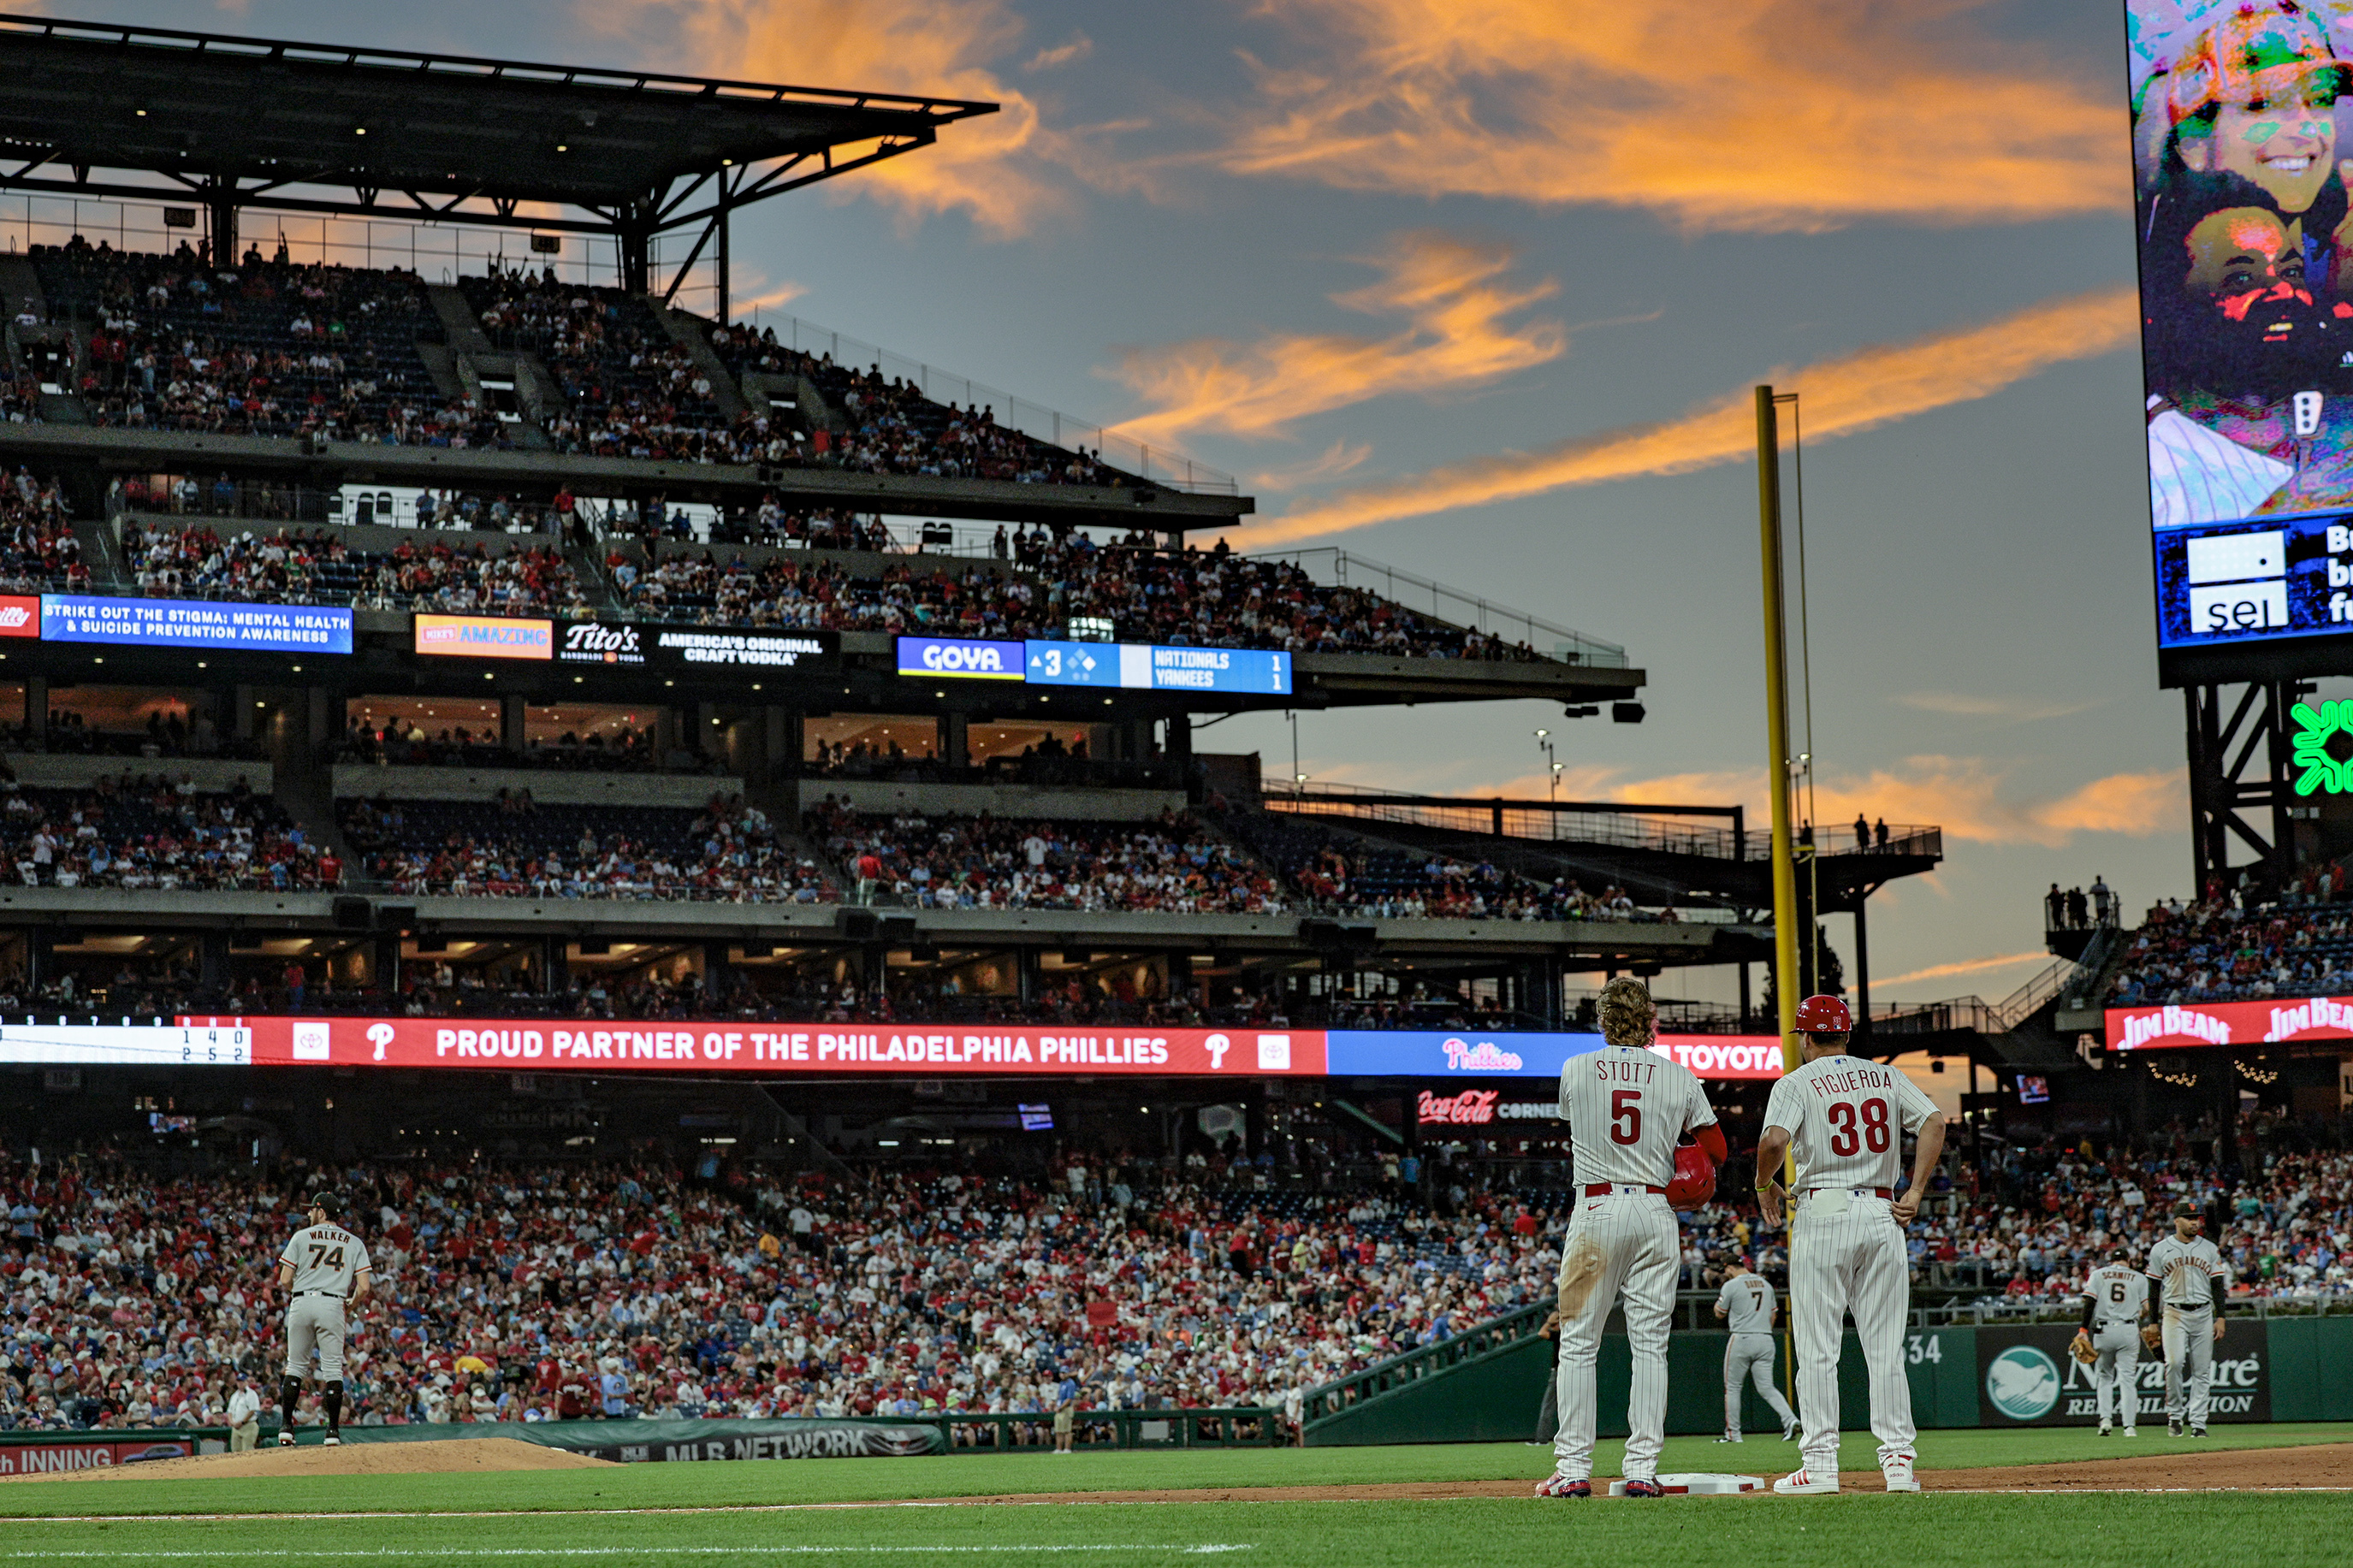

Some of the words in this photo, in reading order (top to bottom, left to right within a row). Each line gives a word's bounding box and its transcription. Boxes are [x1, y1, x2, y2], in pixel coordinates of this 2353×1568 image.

[2326, 524, 2353, 553] B
[2327, 558, 2353, 588] b
[0, 606, 31, 627] illy
[44, 604, 96, 618] STRIKE
[101, 606, 131, 619] OUT
[135, 608, 163, 621] THE
[168, 610, 228, 624] STIGMA:
[233, 612, 290, 627] MENTAL
[294, 615, 350, 630] HEALTH
[66, 619, 76, 632] &
[81, 620, 140, 635] SUICIDE
[146, 624, 236, 640] PREVENTION
[241, 628, 329, 643] AWARENESS
[459, 625, 548, 647] AMAZING
[566, 623, 641, 653] Tito's
[658, 632, 745, 650] AMERICA'S
[747, 637, 822, 654] ORIGINAL
[684, 648, 736, 663] CRAFT
[922, 645, 1000, 671] GOYA
[1045, 649, 1062, 677] 3
[1155, 650, 1230, 670] NATIONALS
[1272, 655, 1282, 672] 1
[1155, 669, 1214, 688] YANKEES
[1273, 674, 1283, 690] 1
[2117, 1013, 2163, 1050] JIM
[2163, 1005, 2231, 1044] BEAM
[2263, 1004, 2309, 1042] JIM
[183, 1030, 190, 1044] 1
[209, 1031, 217, 1044] 4
[436, 1029, 543, 1058] PROUD
[552, 1031, 695, 1060] PARTNER
[703, 1032, 743, 1060] OF
[750, 1033, 809, 1061] THE
[817, 1033, 1033, 1062] PHILADELPHIA
[1039, 1037, 1169, 1064] PHILLIES
[1442, 1038, 1523, 1070] Phillies
[1674, 1044, 1783, 1071] TOYOTA
[1597, 1060, 1657, 1084] STOTT
[1811, 1069, 1893, 1098] FIGUEROA
[1610, 1089, 1642, 1145] 5
[1828, 1098, 1890, 1157] 38
[309, 1230, 351, 1245] WALKER
[308, 1244, 345, 1272] 74
[2101, 1271, 2137, 1282] SCHMITT
[1751, 1291, 1763, 1312] 7
[2110, 1282, 2126, 1303] 6
[1901, 1334, 1942, 1364] 34
[734, 1429, 869, 1459] NETWORK
[0, 1454, 14, 1473] h
[21, 1448, 111, 1472] INNING
